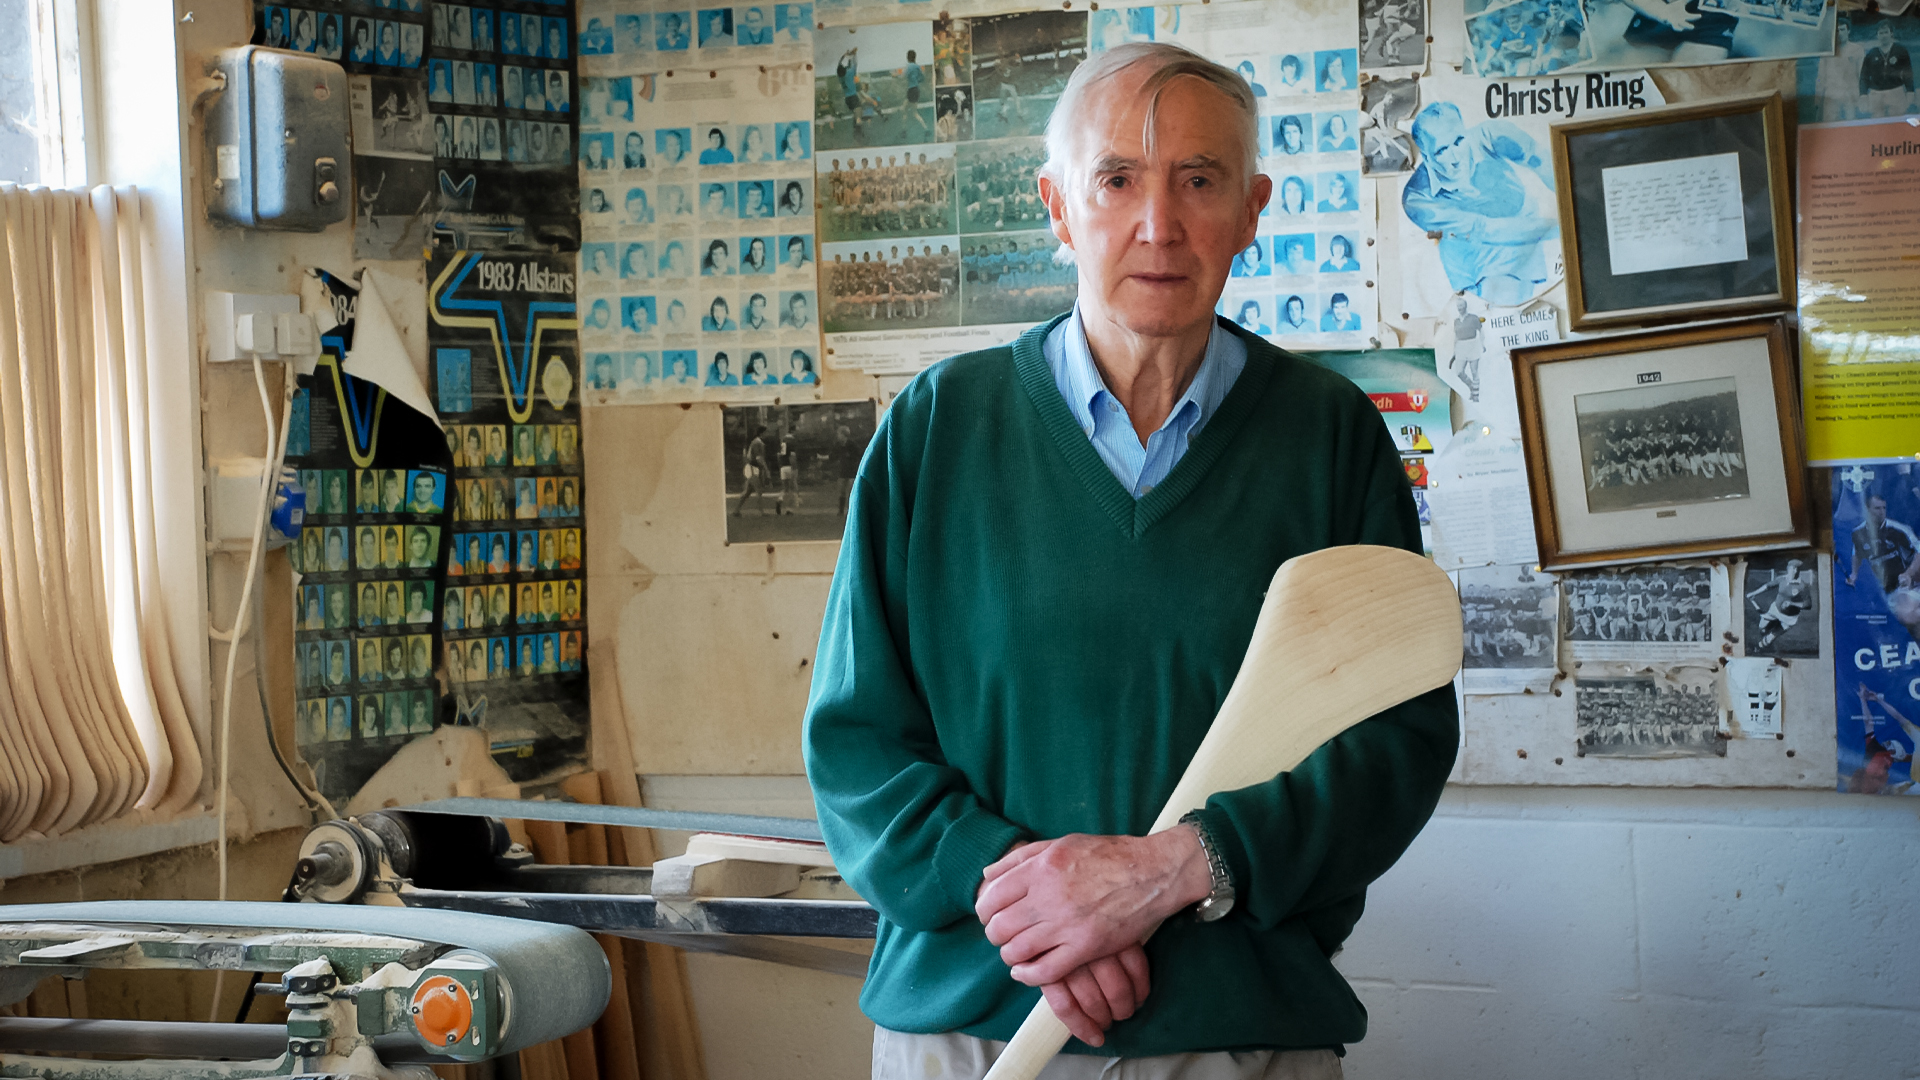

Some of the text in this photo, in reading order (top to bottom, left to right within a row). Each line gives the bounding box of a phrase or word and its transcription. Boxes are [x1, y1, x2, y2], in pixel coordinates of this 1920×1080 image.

[1485, 71, 1646, 119] Christy Ring
[1871, 140, 1920, 157] Hurlin
[476, 260, 575, 295] 1983 Allstars
[1490, 309, 1554, 329] HERE COMES
[1500, 330, 1550, 348] THE KING
[1637, 372, 1660, 384] 1942
[1373, 396, 1393, 409] dh
